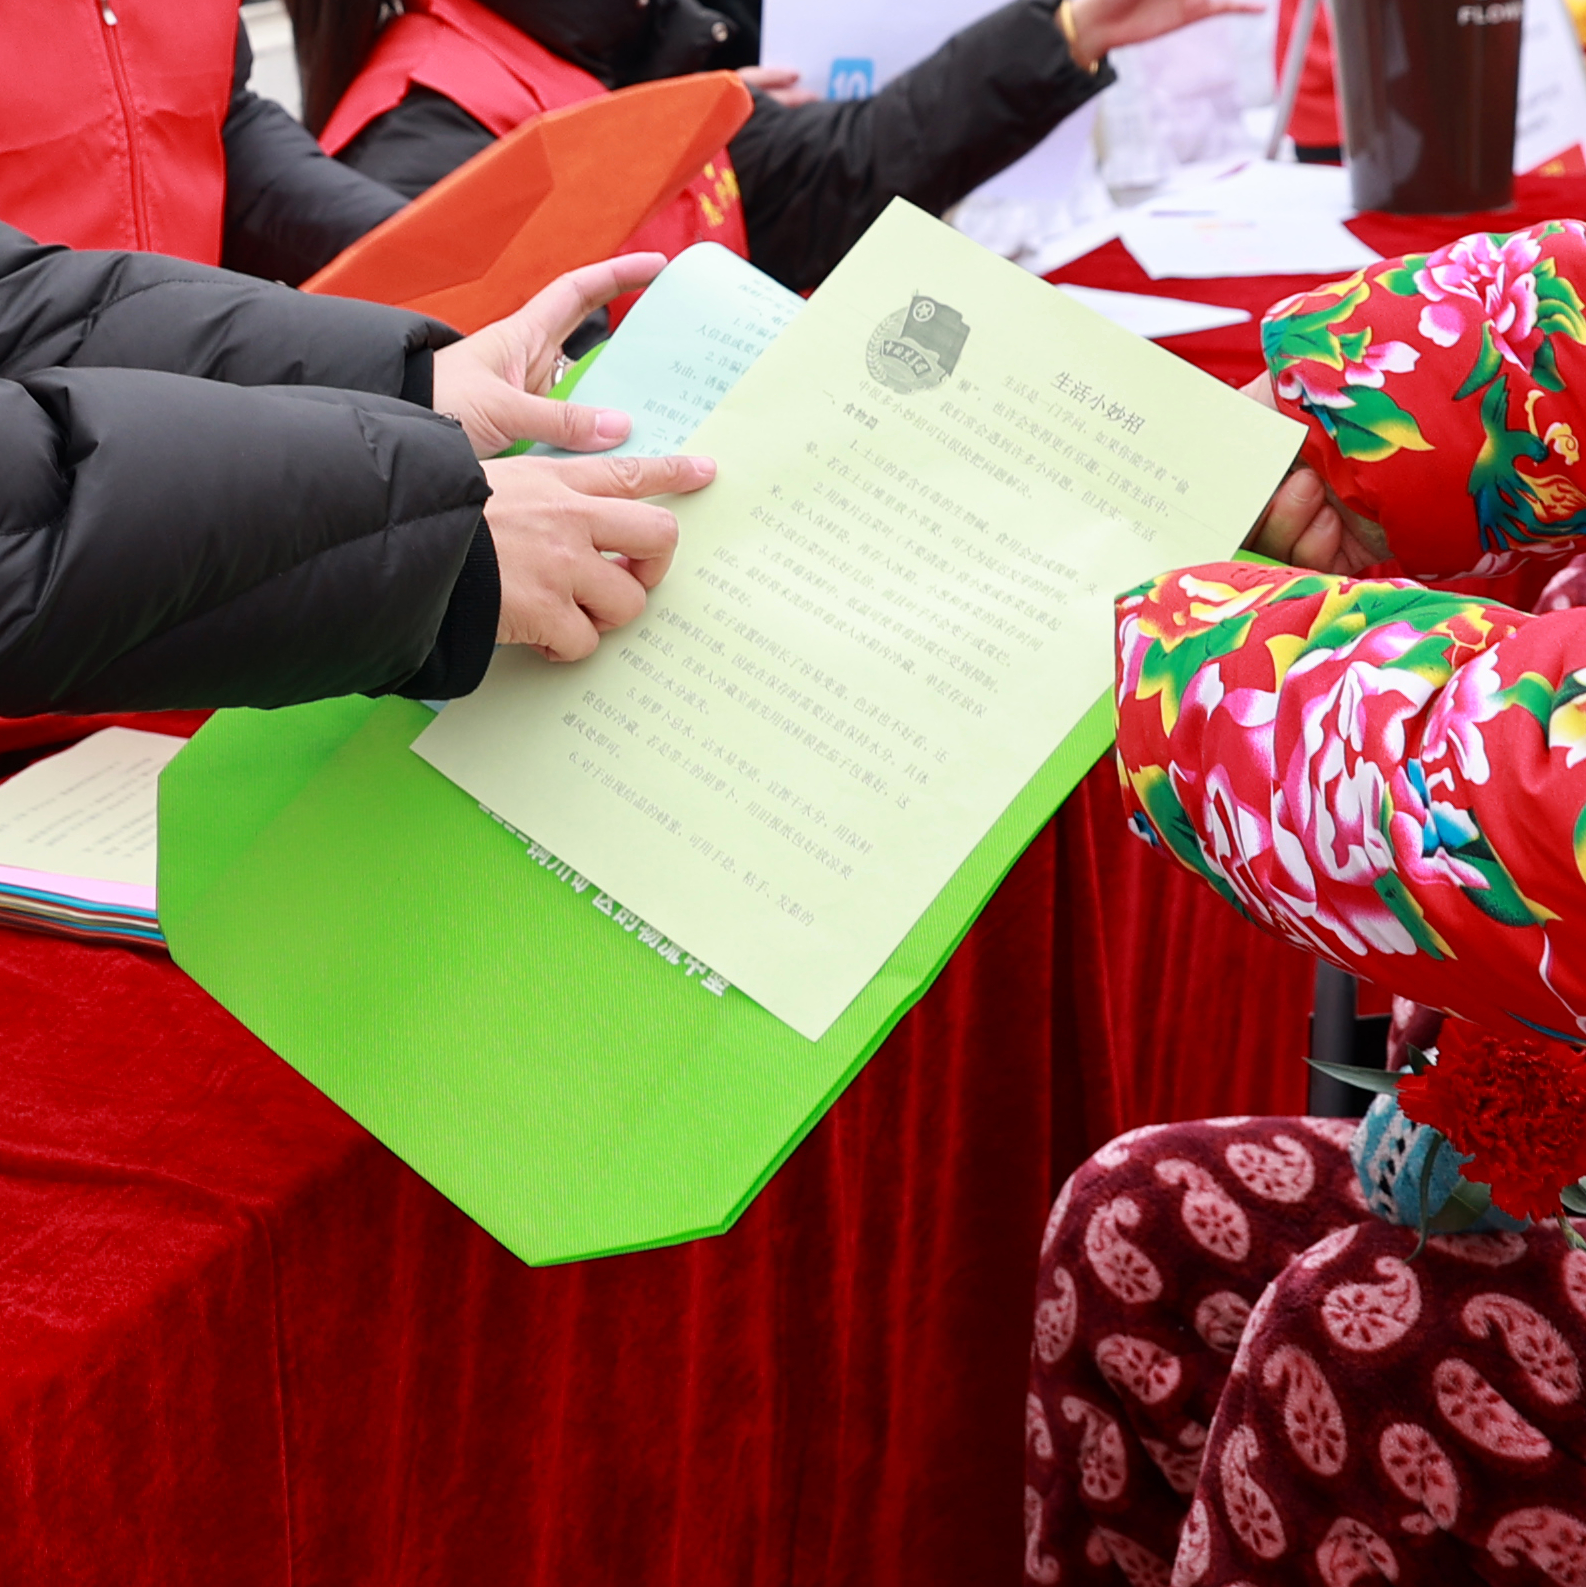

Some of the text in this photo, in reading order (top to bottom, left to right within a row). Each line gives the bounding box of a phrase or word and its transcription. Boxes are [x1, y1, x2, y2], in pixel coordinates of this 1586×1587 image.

[815, 385, 882, 431] 一、食物篇
[1048, 369, 1148, 436] 生活小妙招
[692, 564, 757, 610] 鲜效果更好。
[616, 645, 716, 717] 样能防止水分流失。
